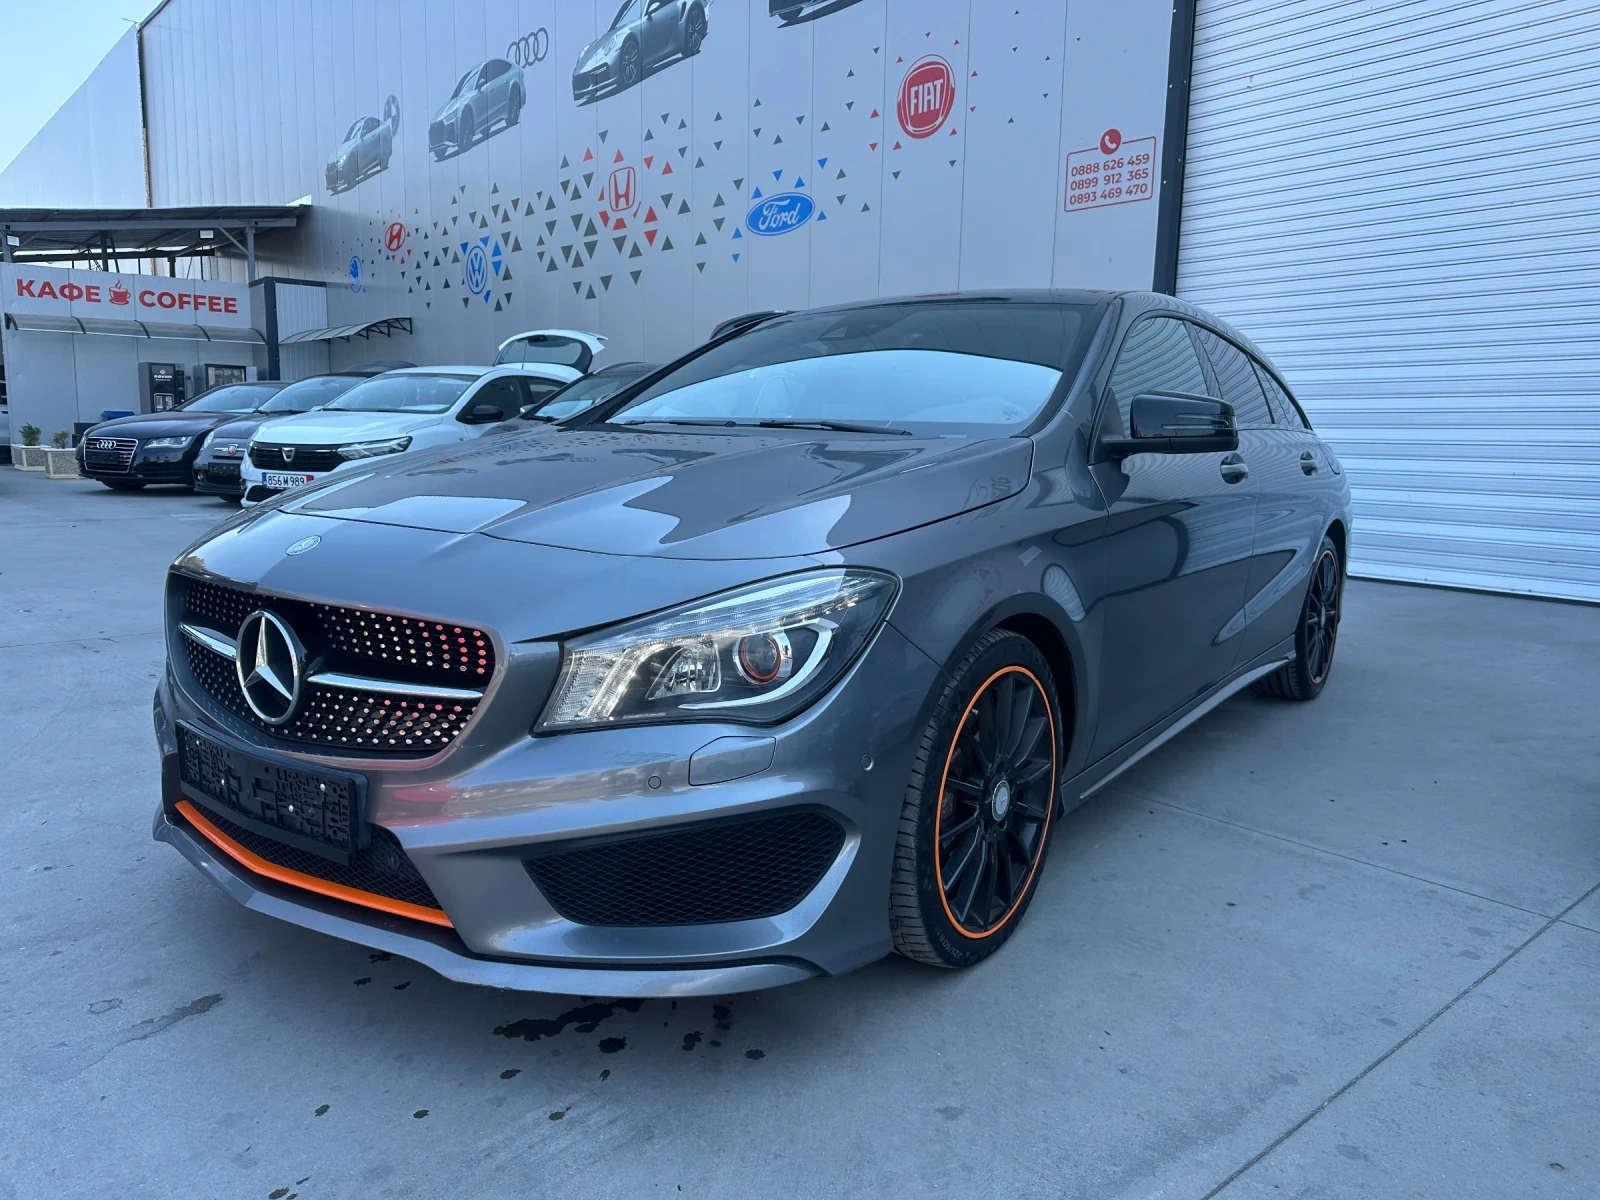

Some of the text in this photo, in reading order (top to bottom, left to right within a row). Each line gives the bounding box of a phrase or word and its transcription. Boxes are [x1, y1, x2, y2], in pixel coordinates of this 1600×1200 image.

[910, 78, 944, 116] FIAT
[1071, 153, 1149, 177] 0888 626 459
[1070, 168, 1149, 191] 0899 912 365
[1069, 183, 1148, 205] 0893 469 470
[758, 198, 801, 231] Ford
[16, 278, 101, 303] КАФЕ
[139, 289, 238, 314] COFFEE
